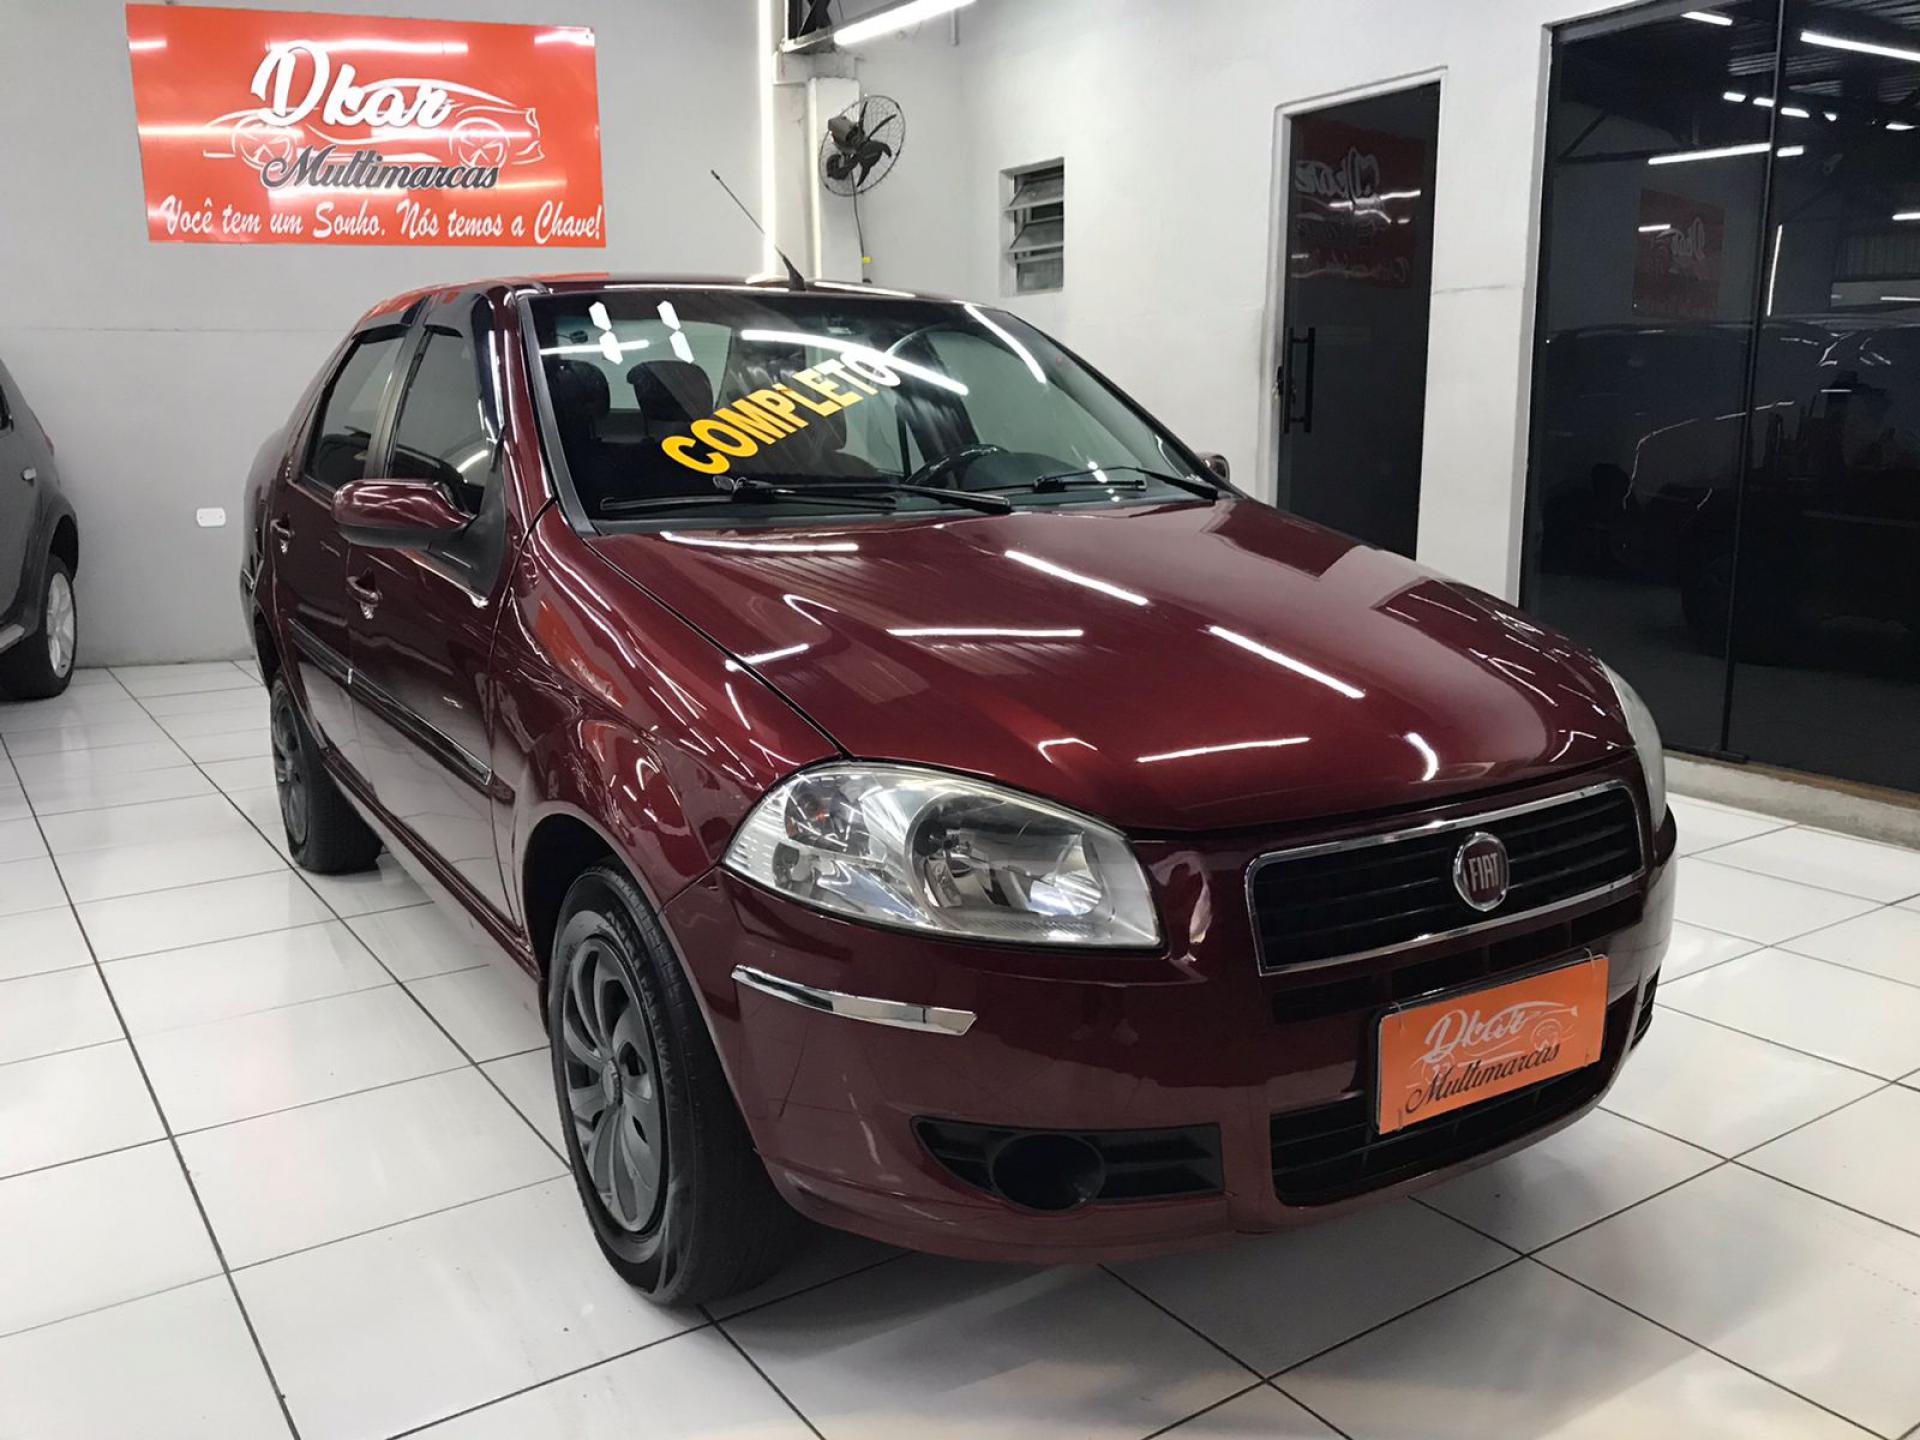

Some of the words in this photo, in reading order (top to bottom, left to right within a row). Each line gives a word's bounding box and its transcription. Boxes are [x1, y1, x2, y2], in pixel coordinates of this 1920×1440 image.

[262, 145, 500, 190] Multimarcas
[160, 195, 214, 235] Você
[222, 204, 262, 236] tem
[270, 212, 303, 235] um
[313, 200, 386, 239] Sonho.
[396, 198, 440, 240] Nós
[449, 209, 503, 239] temos
[511, 214, 526, 237] a
[534, 200, 603, 245] Chave!
[661, 349, 901, 475] COMPLETO
[1468, 852, 1499, 892] FIAT
[1405, 1043, 1561, 1114] Multimarcas
